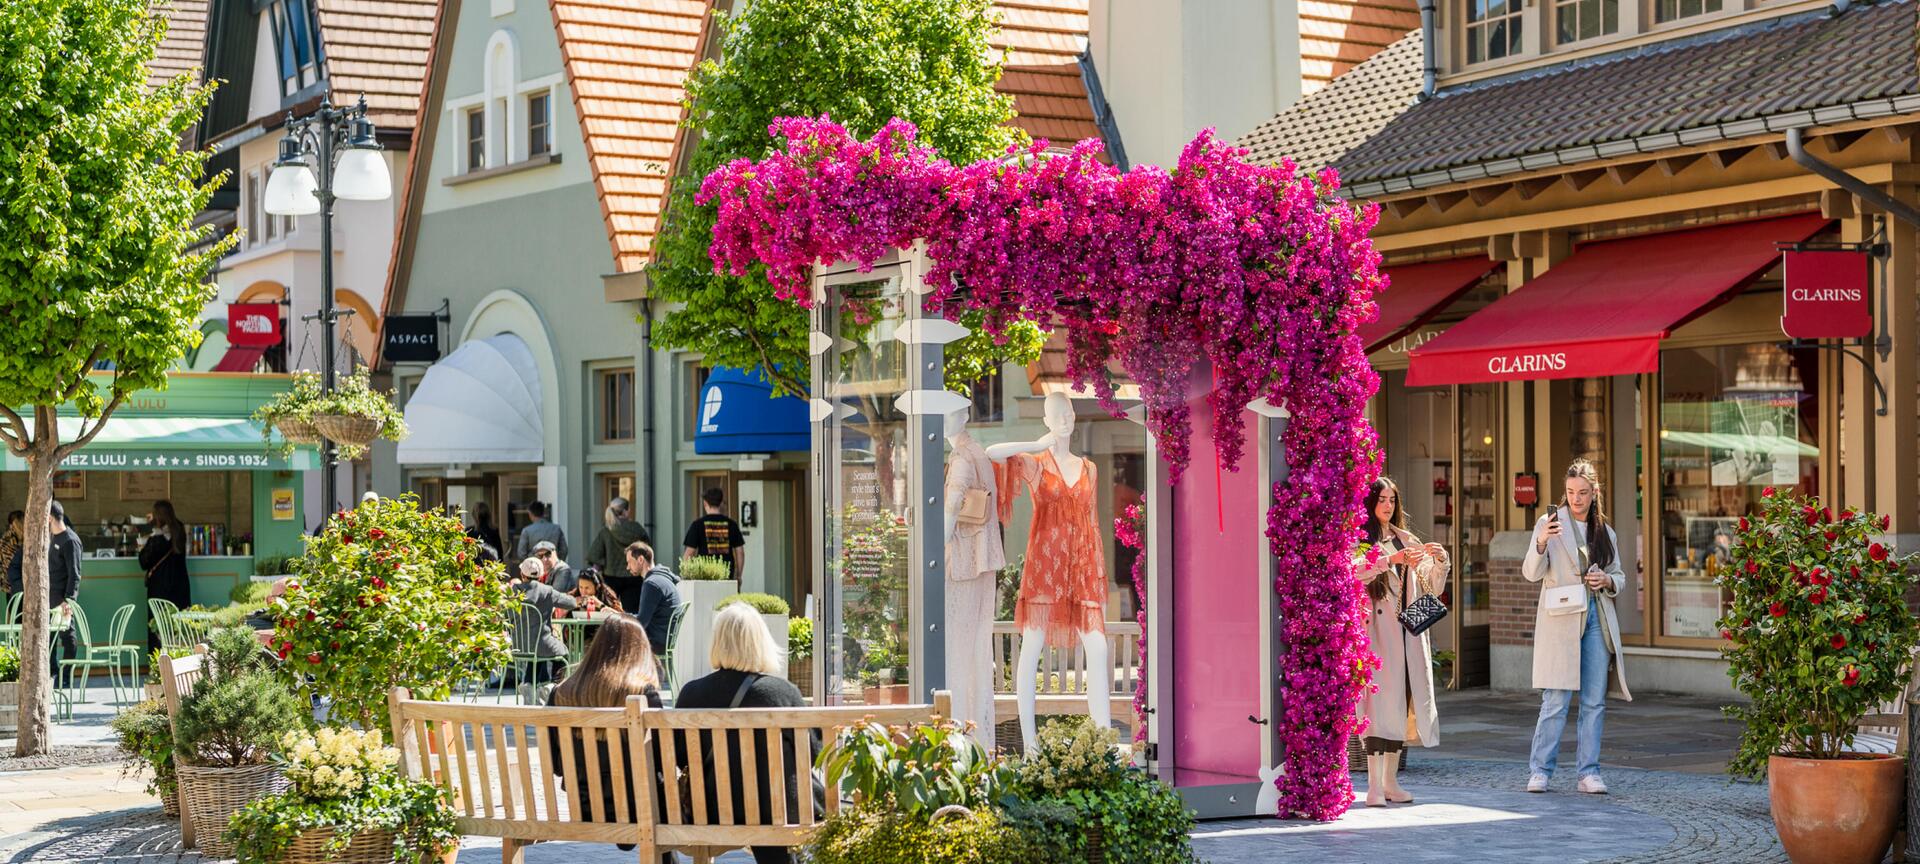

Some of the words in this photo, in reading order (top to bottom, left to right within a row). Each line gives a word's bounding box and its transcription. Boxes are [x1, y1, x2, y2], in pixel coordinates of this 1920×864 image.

[1792, 288, 1861, 301] CLARINS
[235, 320, 260, 328] NORTH
[390, 334, 434, 344] ASPACT
[1488, 352, 1566, 374] CLARINS
[129, 399, 167, 409] LULU
[61, 454, 89, 466] HEZ
[92, 454, 127, 466] LULU
[196, 454, 236, 466] SINDS
[239, 455, 269, 466] 1932
